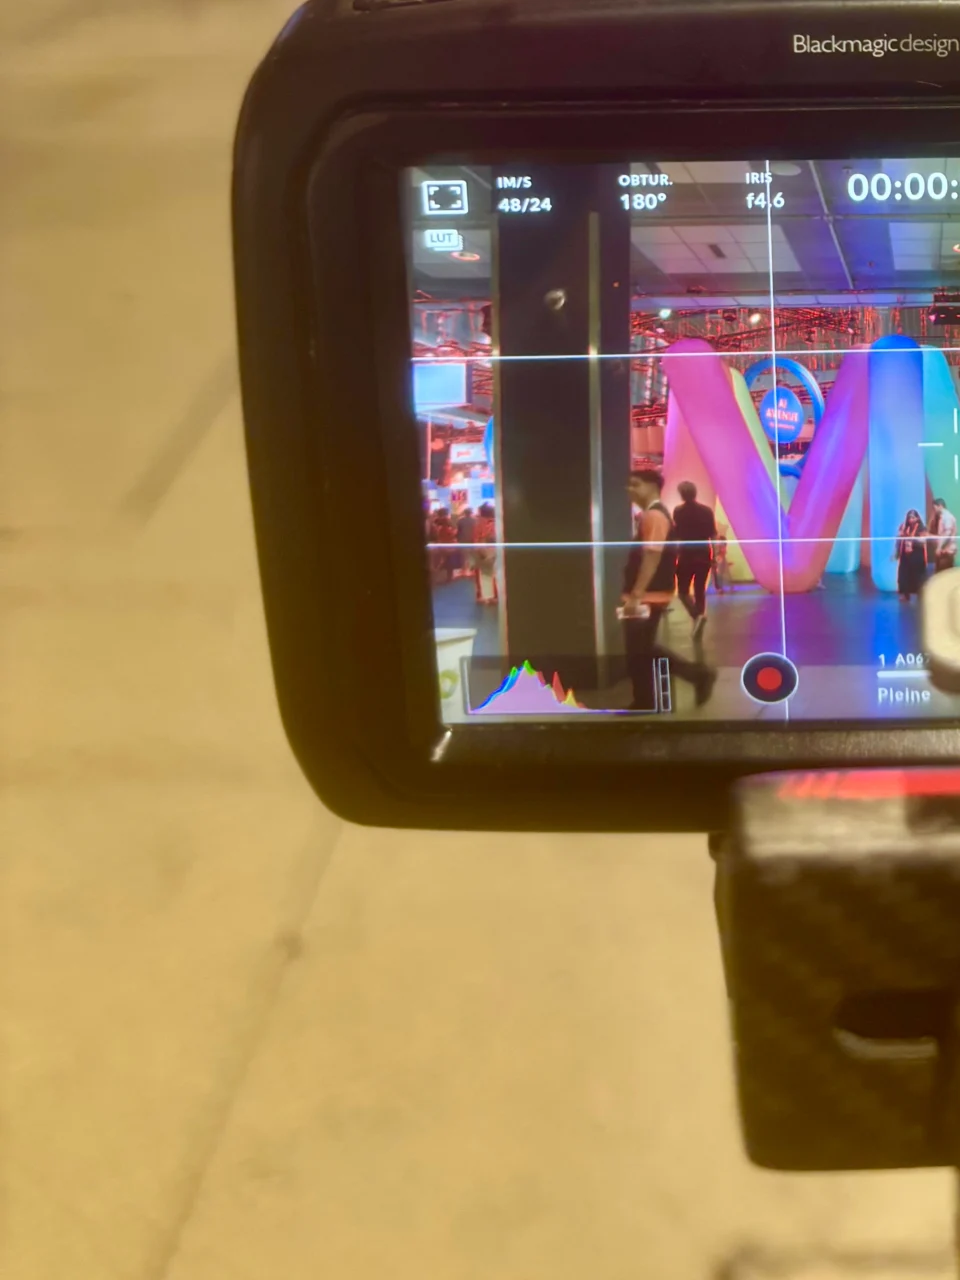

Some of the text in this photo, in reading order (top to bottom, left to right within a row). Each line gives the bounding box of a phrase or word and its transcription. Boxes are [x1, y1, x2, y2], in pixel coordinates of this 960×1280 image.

[496, 176, 532, 188] IM/S
[618, 174, 673, 187] OBTUR.
[745, 172, 773, 184] IRIS
[497, 197, 552, 213] 48/24
[620, 192, 667, 211] 180°
[430, 233, 453, 243] LUT
[877, 687, 931, 704] Pleine
